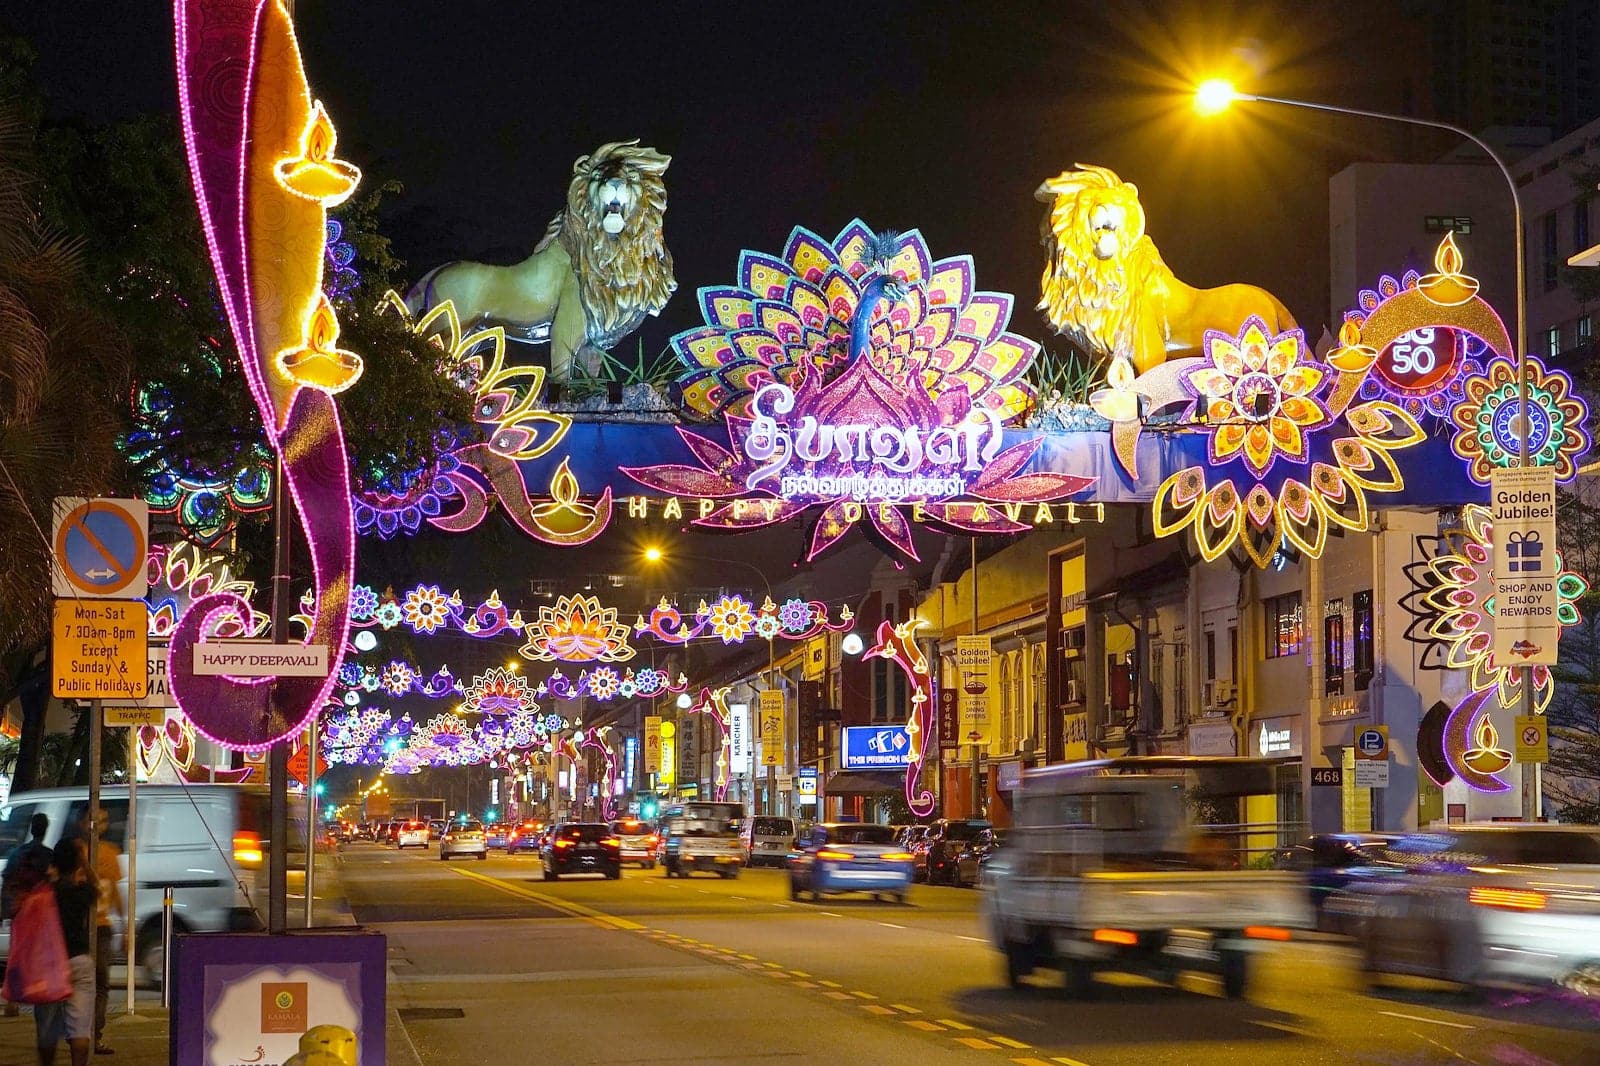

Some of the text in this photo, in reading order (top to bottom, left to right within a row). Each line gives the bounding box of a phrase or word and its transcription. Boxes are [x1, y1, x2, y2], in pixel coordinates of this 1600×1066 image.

[1394, 328, 1434, 345] G
[1391, 345, 1435, 374] 50
[745, 384, 1003, 490] தீபாவளி
[781, 471, 966, 502] நல்வாழ்த்துக்கள்
[1497, 490, 1551, 504] Golden
[629, 497, 1105, 523] HAPPY DEEPAVALI
[1495, 505, 1553, 519] Jubilee!
[1499, 583, 1552, 593] SHOP AND
[1508, 595, 1543, 604] ENJOY
[75, 607, 126, 620] Mon-Sat
[1500, 607, 1552, 616] REWARDS
[65, 625, 135, 641] 7.30am-8pm
[82, 643, 119, 659] Except
[960, 648, 989, 656] Golden
[203, 655, 318, 666] HAPPY DEEPAVALI
[71, 660, 128, 676] Sunday &
[58, 678, 141, 693] Public Holidays
[849, 756, 866, 764] THE
[1314, 771, 1340, 783] 468
